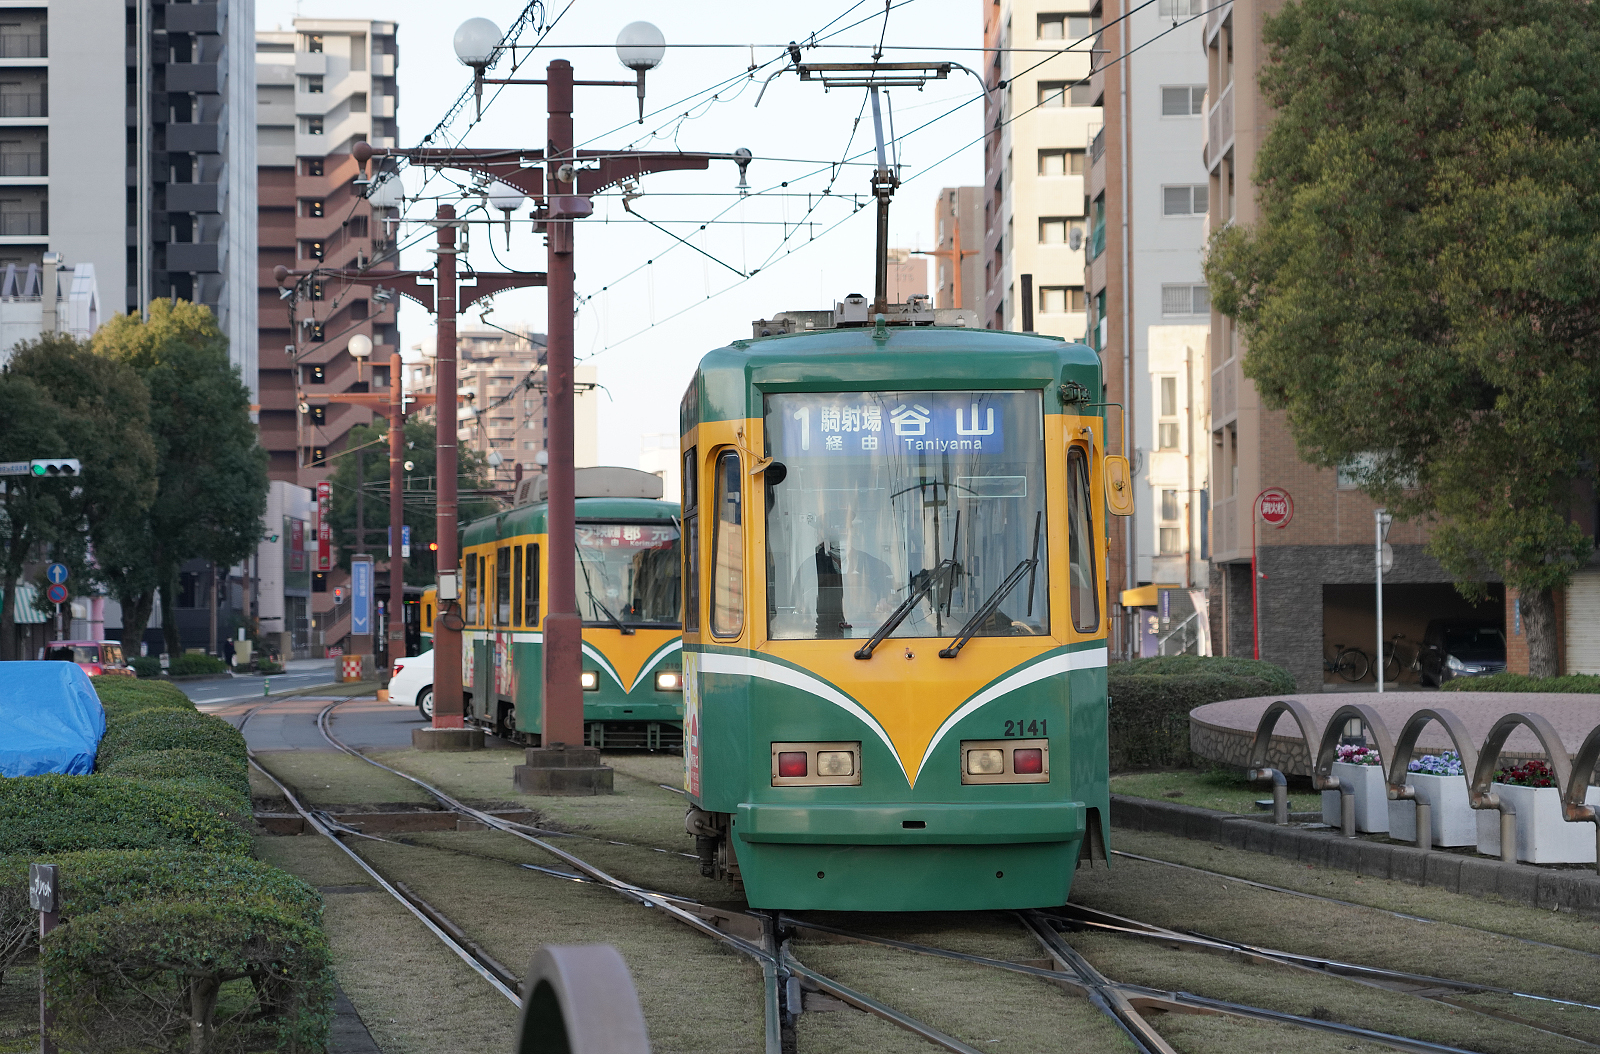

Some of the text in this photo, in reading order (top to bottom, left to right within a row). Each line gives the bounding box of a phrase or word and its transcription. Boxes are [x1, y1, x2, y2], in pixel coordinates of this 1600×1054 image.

[820, 404, 882, 433] 騎射場
[890, 403, 995, 436] 谷山
[793, 406, 810, 451] 1
[825, 434, 878, 451] 経由
[905, 438, 983, 452] Taniyama
[1262, 501, 1286, 514] 消火栓
[1004, 718, 1047, 736] 2141
